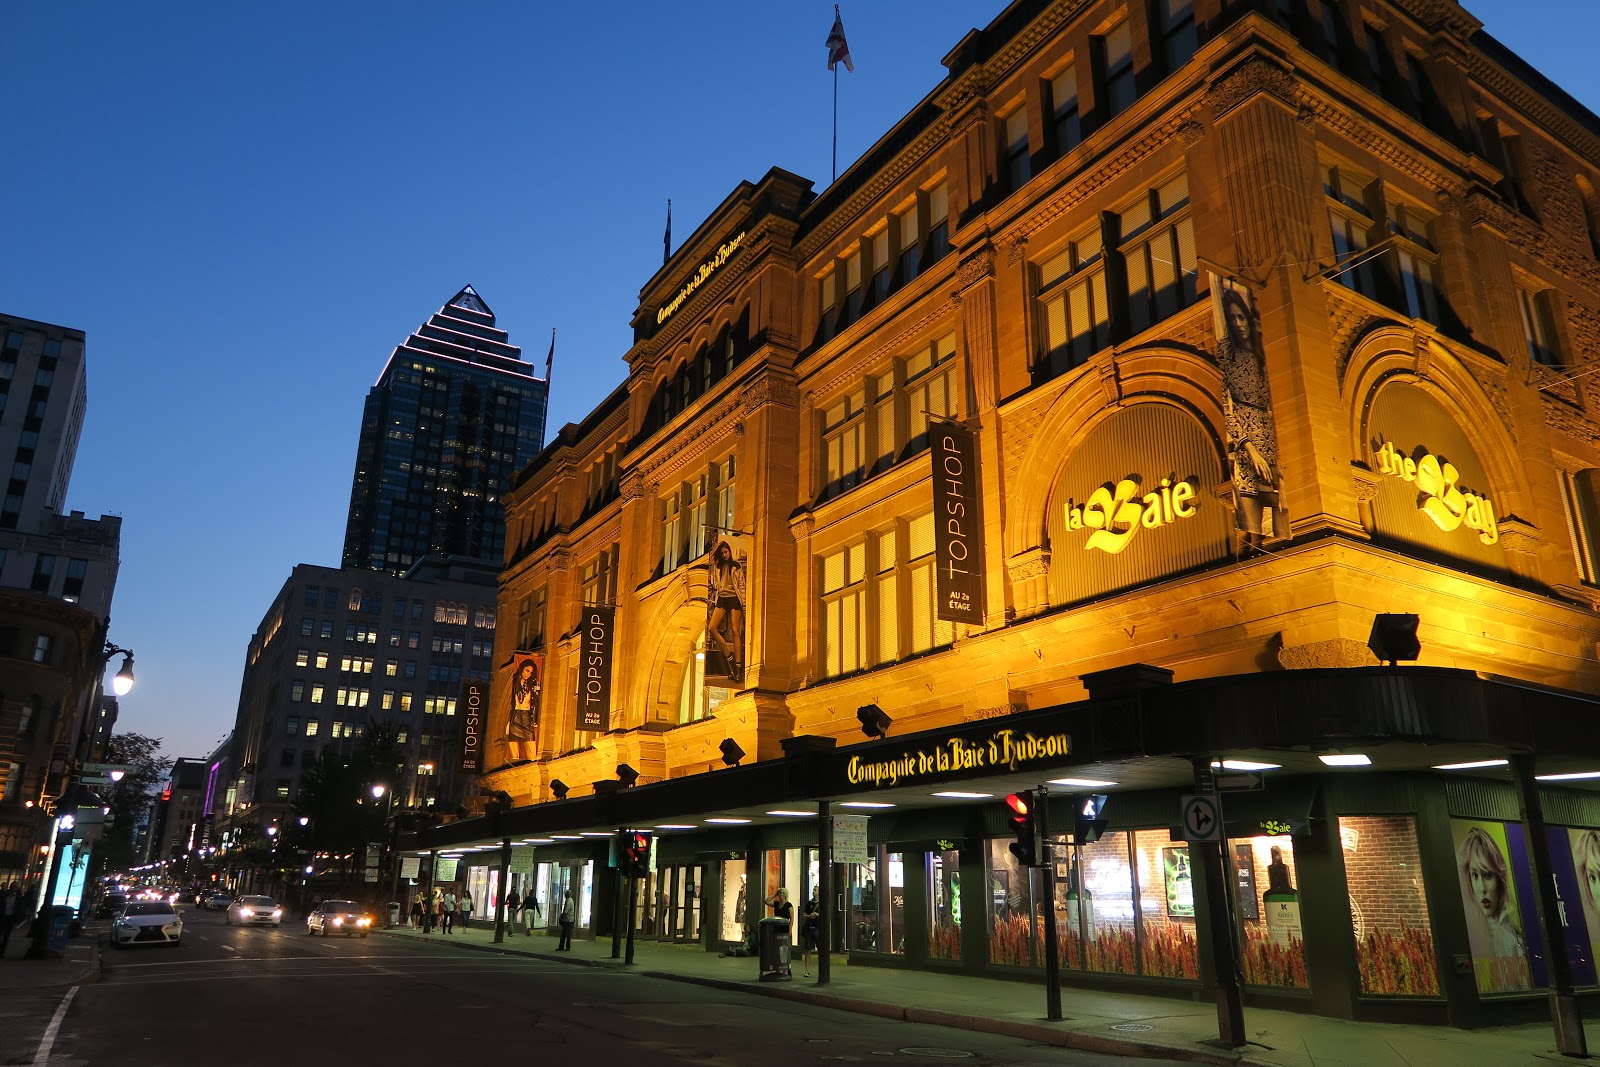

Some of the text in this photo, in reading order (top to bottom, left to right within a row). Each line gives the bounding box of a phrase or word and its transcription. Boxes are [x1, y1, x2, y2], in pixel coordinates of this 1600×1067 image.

[657, 289, 687, 324] Compagnie
[687, 281, 695, 295] de
[694, 275, 700, 288] la
[699, 261, 714, 284] Baie
[943, 436, 969, 580] TOPSHOP
[1063, 477, 1197, 555] la Baie
[1374, 441, 1499, 545] the Bay
[949, 600, 971, 611] ÉTAGE
[950, 591, 970, 601] AU 2e
[586, 614, 605, 706] TOPSHOP
[464, 686, 481, 755] TOPSHOP
[847, 729, 1069, 787] Compagnie de la Baie d'Hudson
[1265, 820, 1291, 835] Baie
